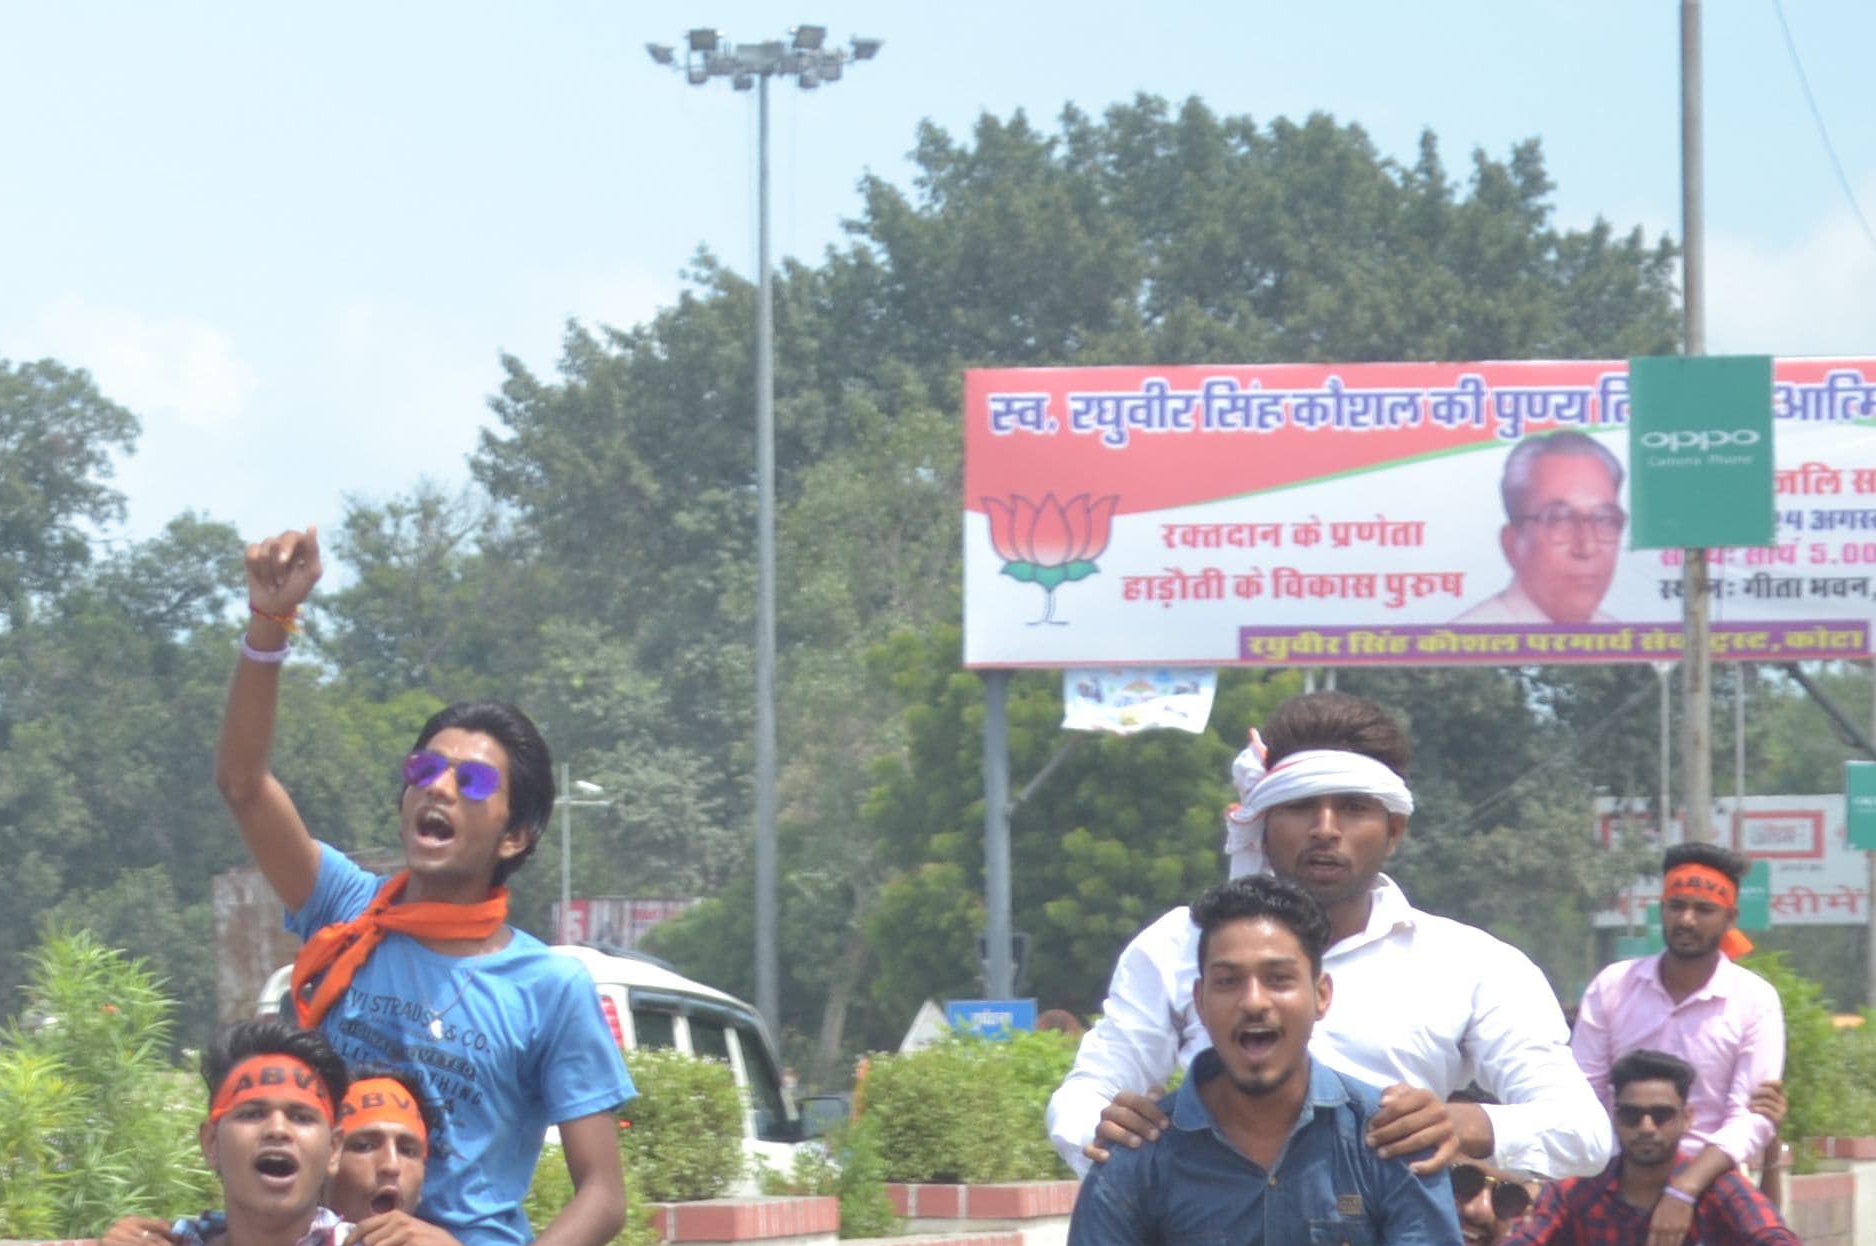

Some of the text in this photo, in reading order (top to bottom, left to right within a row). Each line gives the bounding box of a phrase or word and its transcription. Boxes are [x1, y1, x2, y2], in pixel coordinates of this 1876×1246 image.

[990, 393, 1058, 432] स्व.
[1070, 379, 1197, 446] रघुवीर
[1203, 379, 1284, 431] सिंह
[1291, 376, 1421, 431] कौशल
[1427, 374, 1488, 428] की
[1494, 387, 1592, 440] पुण्य
[1161, 513, 1425, 549] रक्तदान के प्रणेता
[1233, 566, 1262, 600] के
[1271, 566, 1378, 601] विकास
[1384, 570, 1465, 609] पुरुष
[1743, 571, 1804, 599] गीता
[1248, 630, 1341, 662] रघुवीर
[1347, 629, 1410, 655] सिंह
[1417, 629, 1519, 654] कौशल
[461, 1029, 492, 1055] CO.
